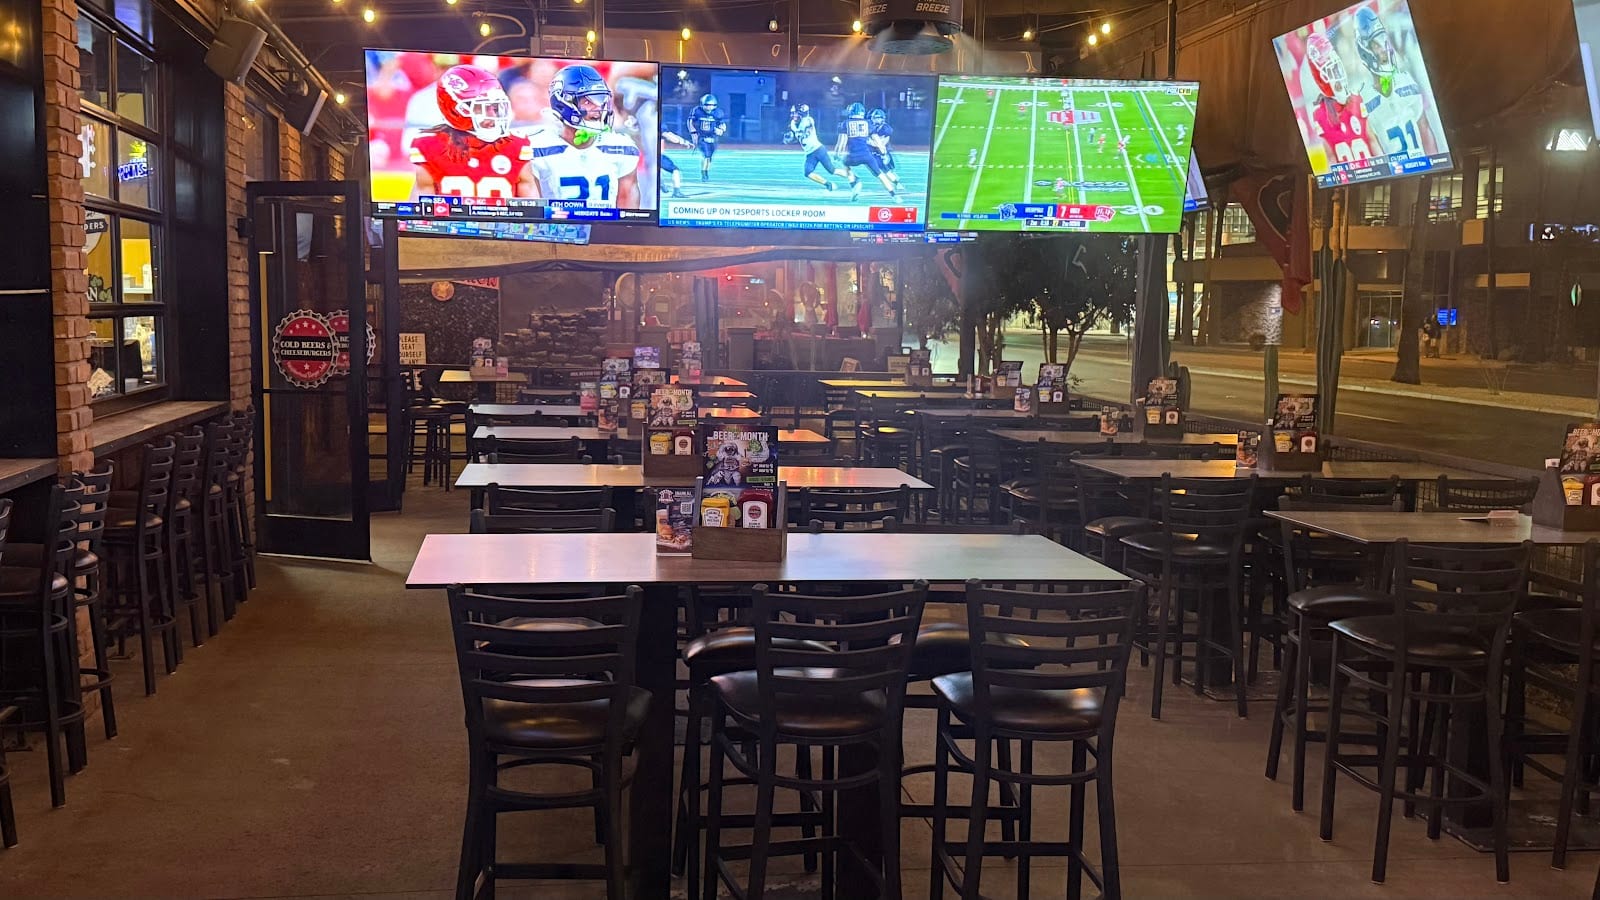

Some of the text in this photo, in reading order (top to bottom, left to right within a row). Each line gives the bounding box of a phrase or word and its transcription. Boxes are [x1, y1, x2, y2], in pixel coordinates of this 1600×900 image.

[916, 2, 951, 14] BREEZE
[673, 206, 705, 215] COMING
[706, 207, 718, 215] UP
[732, 208, 770, 216] 12SPORTS
[802, 209, 826, 218] ROOM
[83, 221, 105, 231] DERS
[280, 341, 300, 349] COLD
[301, 341, 326, 349] BEERS
[280, 349, 332, 357] CHEESEBURGERS
[713, 430, 733, 441] BEER
[740, 431, 768, 441] MONTH
